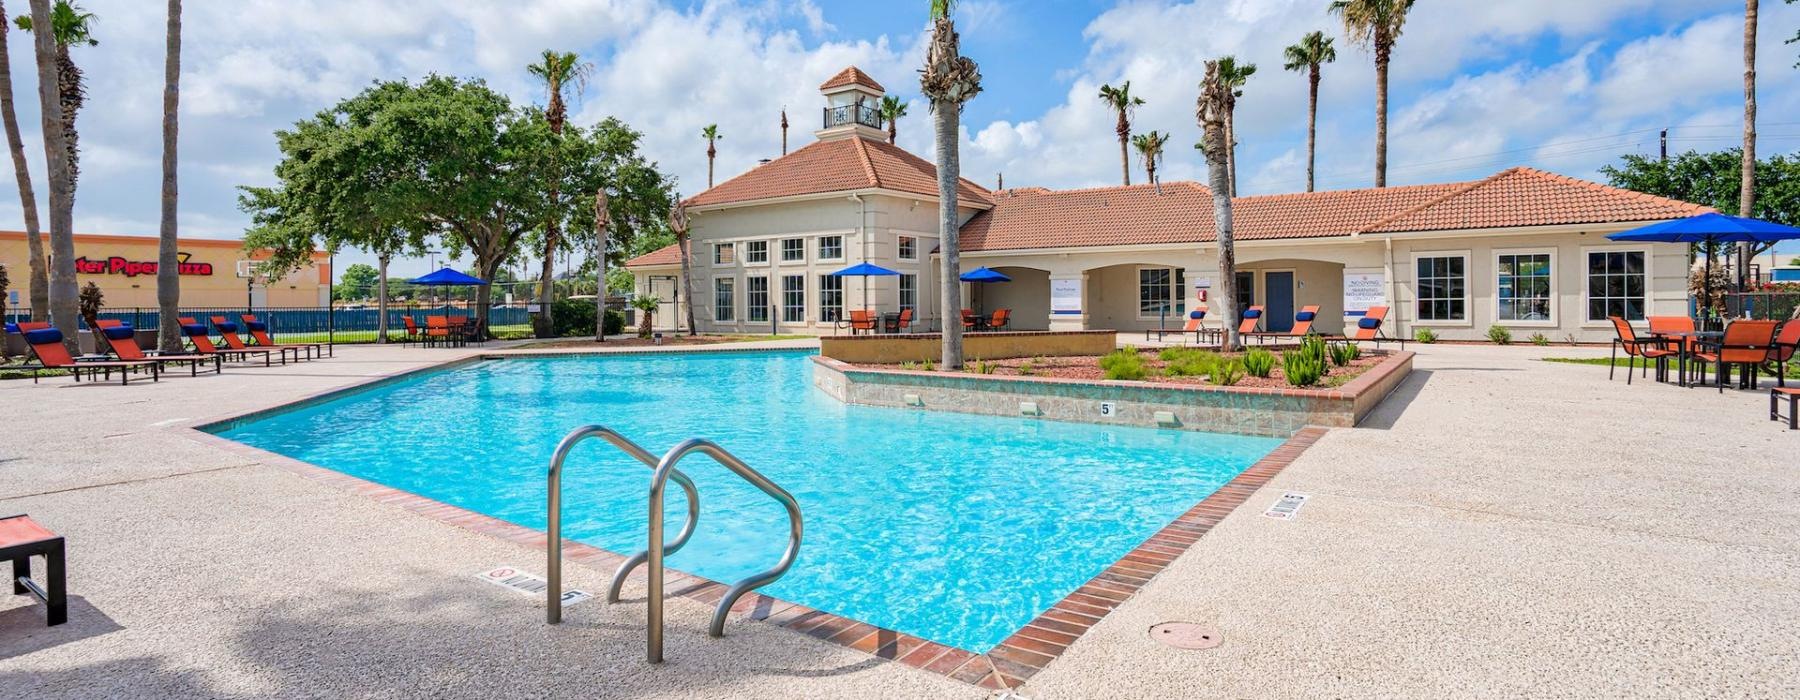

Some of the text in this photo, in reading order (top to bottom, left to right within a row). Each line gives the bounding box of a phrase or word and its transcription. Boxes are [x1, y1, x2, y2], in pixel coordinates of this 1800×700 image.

[75, 256, 107, 274] ter
[178, 263, 213, 276] izza
[1102, 403, 1109, 415] 5
